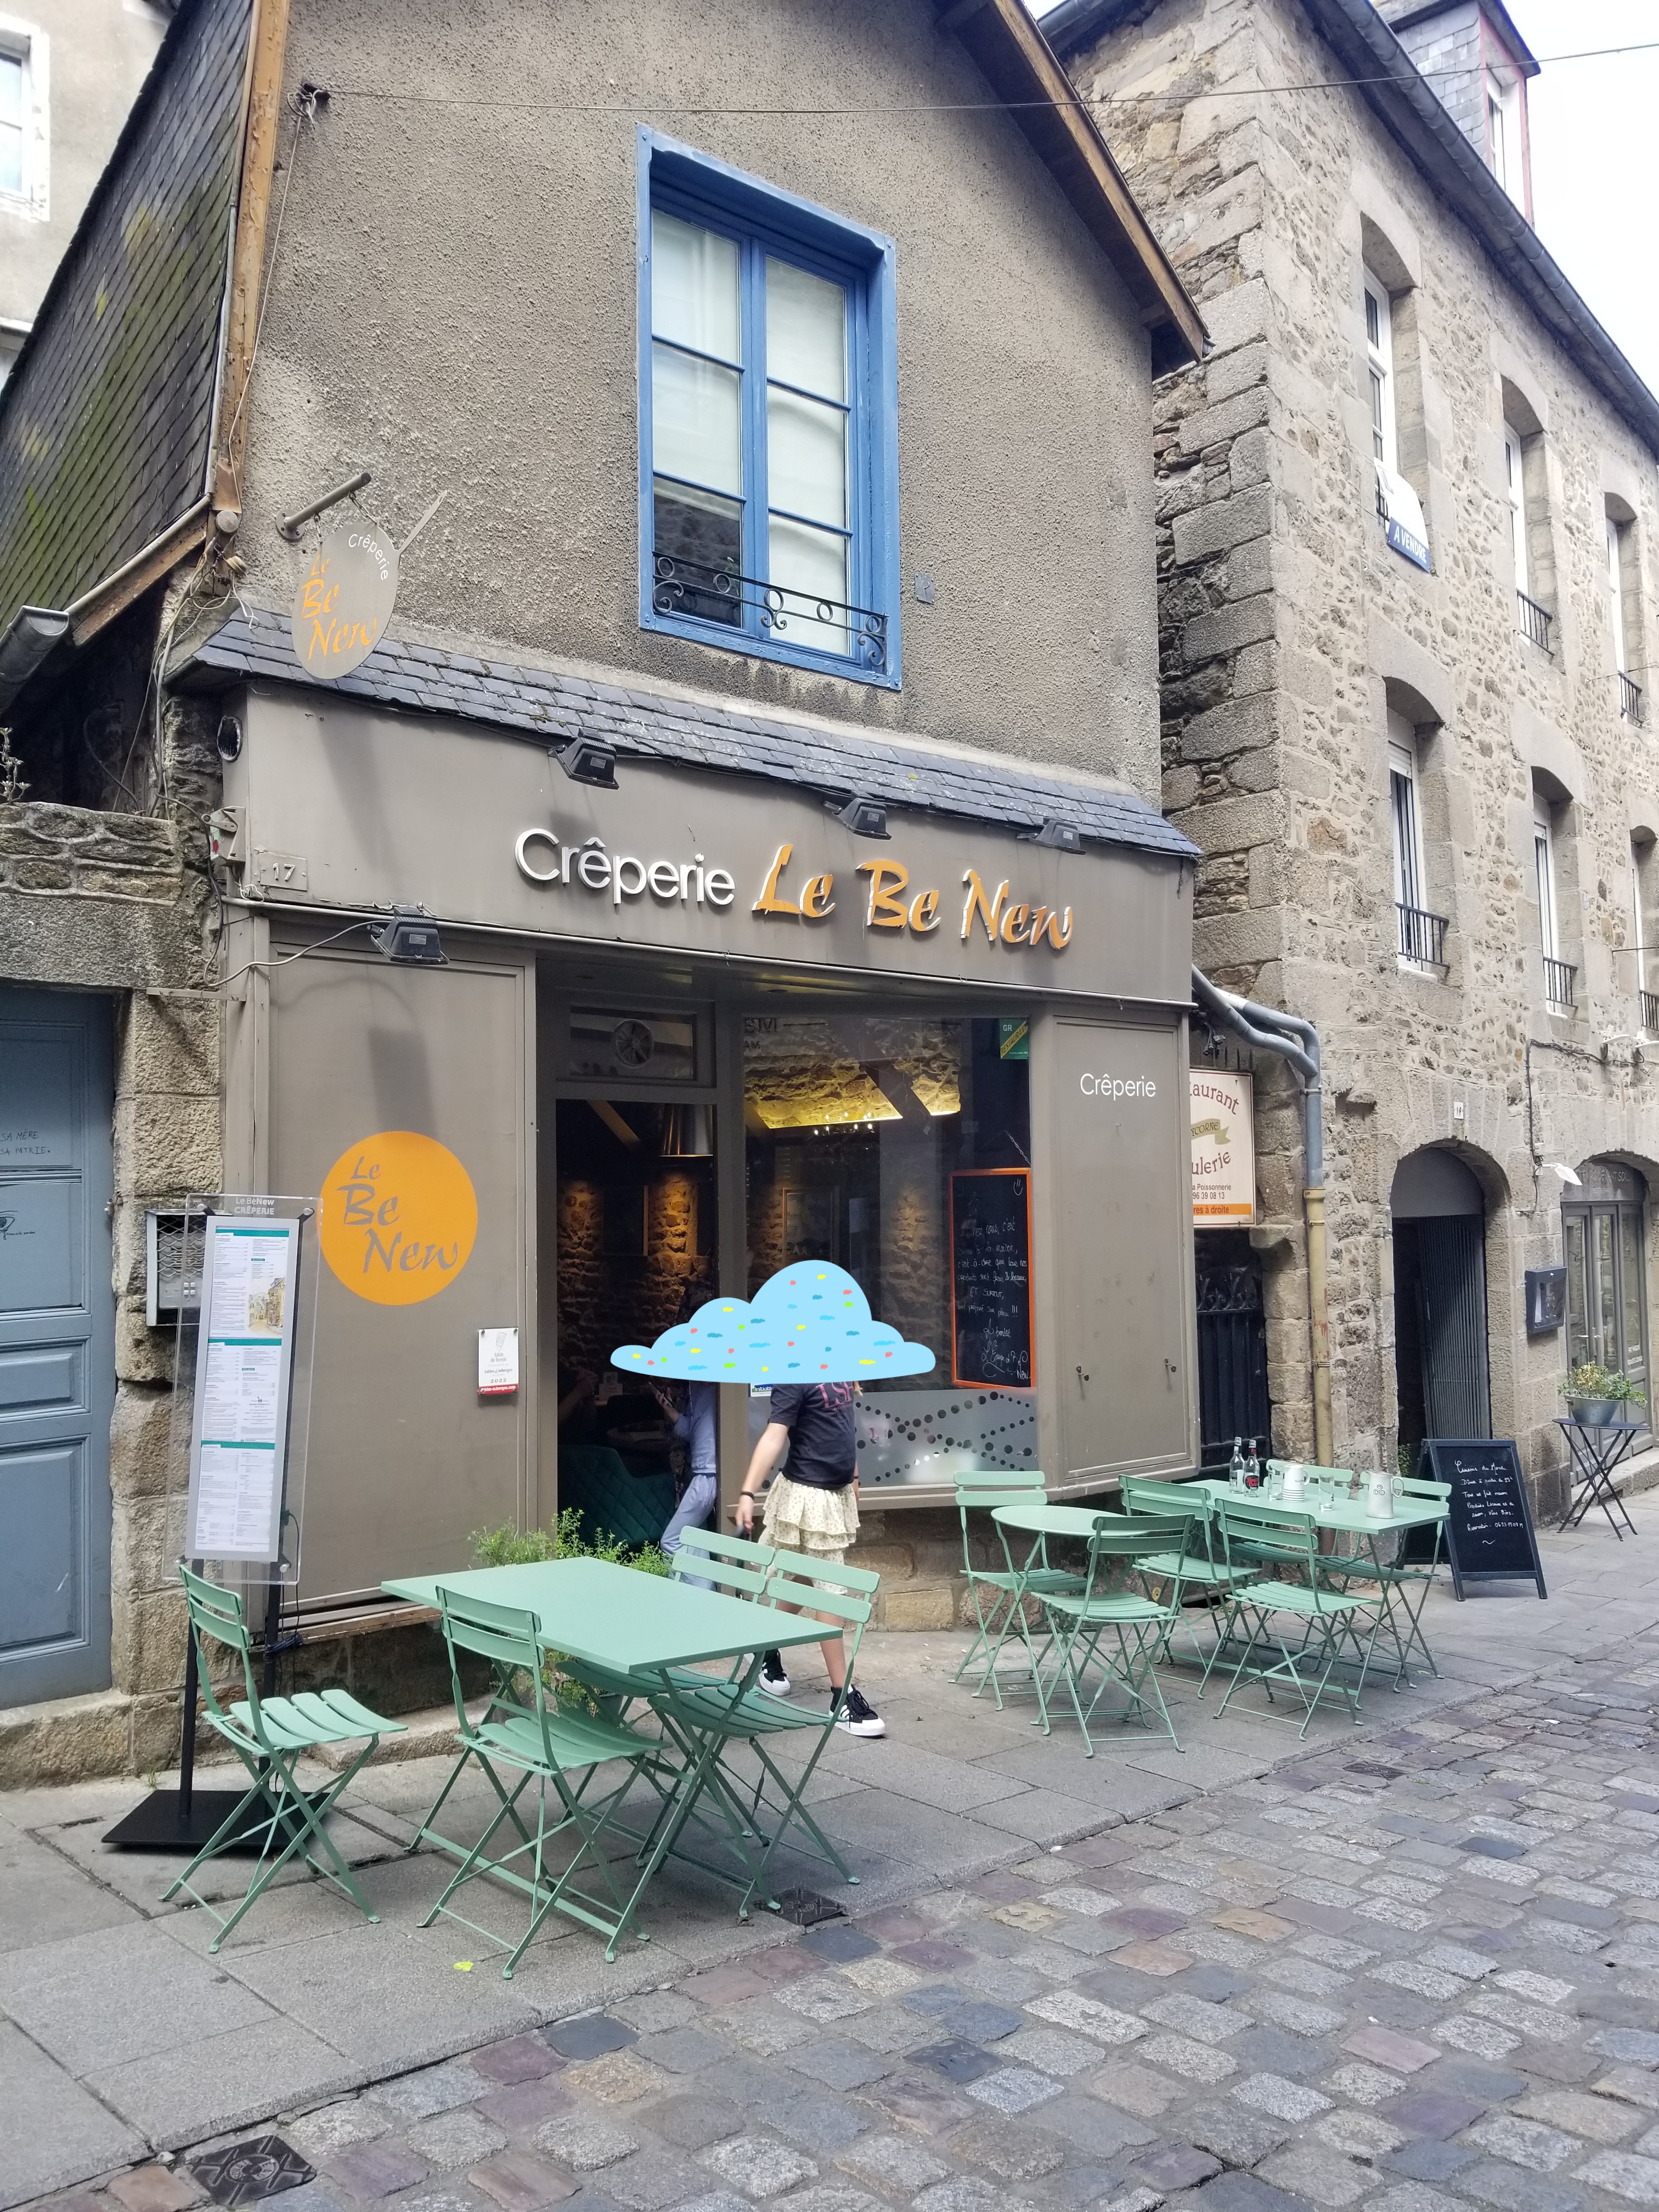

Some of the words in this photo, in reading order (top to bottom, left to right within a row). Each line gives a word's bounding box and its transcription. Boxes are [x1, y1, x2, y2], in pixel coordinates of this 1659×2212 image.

[348, 533, 389, 580] Crêperie
[1393, 525, 1400, 543] A
[1401, 528, 1427, 564] VENDRE
[309, 553, 330, 577] Le
[301, 578, 340, 618] Be
[307, 615, 377, 662] New
[273, 862, 296, 882] 17
[514, 828, 736, 905] Crêperie
[751, 843, 836, 919] Le
[855, 859, 941, 933] Be
[959, 868, 1074, 950] New
[1080, 1073, 1156, 1101] Crêperie
[350, 1155, 381, 1180] Le
[234, 1206, 275, 1215] CRÊPERIE
[336, 1183, 402, 1226] Be
[1201, 1192, 1208, 1200] 39
[1205, 1205, 1209, 1214] à
[1211, 1205, 1229, 1214] droite
[363, 1228, 459, 1274] New
